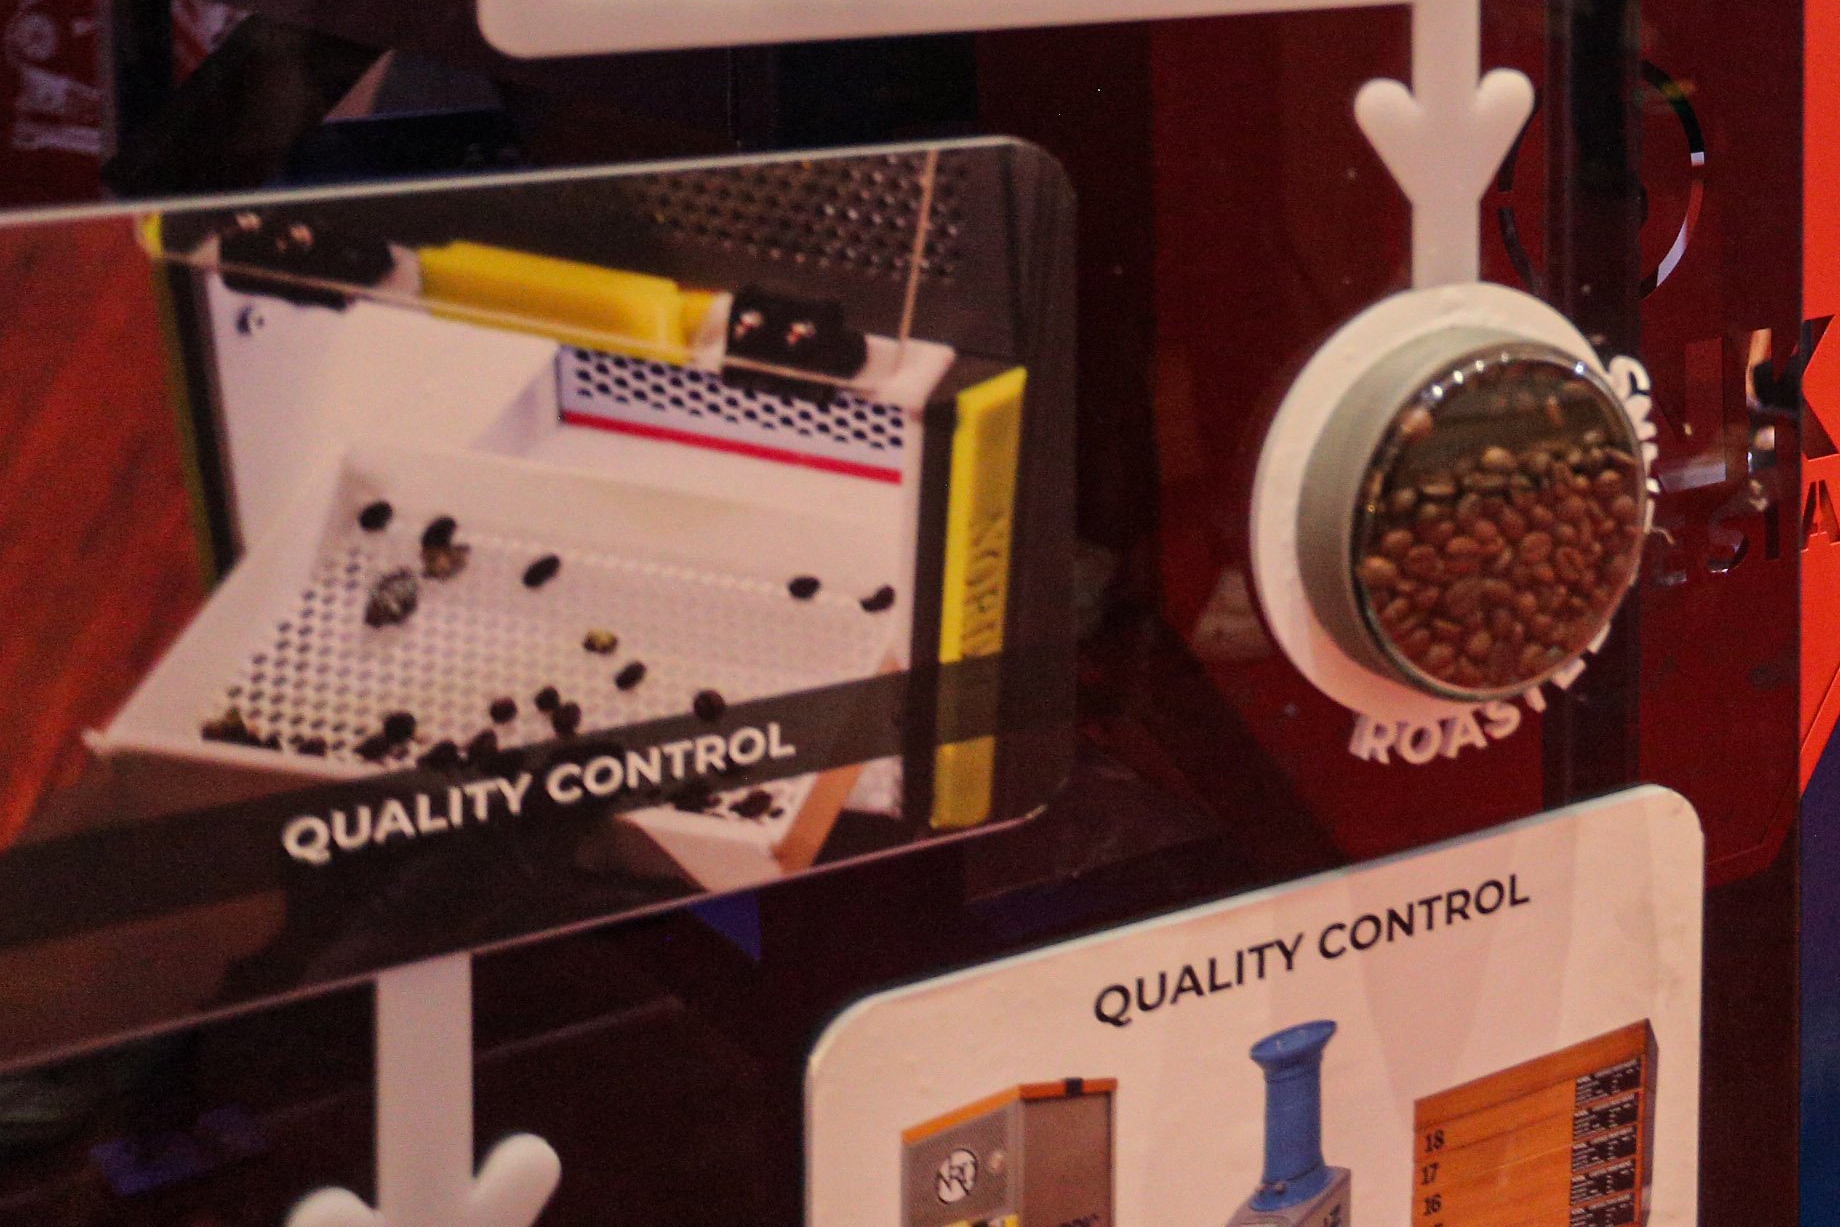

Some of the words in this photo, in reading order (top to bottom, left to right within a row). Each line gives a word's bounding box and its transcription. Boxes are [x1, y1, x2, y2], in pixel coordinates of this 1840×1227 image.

[282, 773, 532, 865] QUALITY
[546, 721, 796, 805] CONTROL
[1093, 933, 1305, 1026] QUALITY
[1318, 873, 1530, 960] CONTROL
[1423, 1128, 1446, 1154] 18
[1420, 1161, 1441, 1187] 17
[1423, 1193, 1444, 1218] 16
